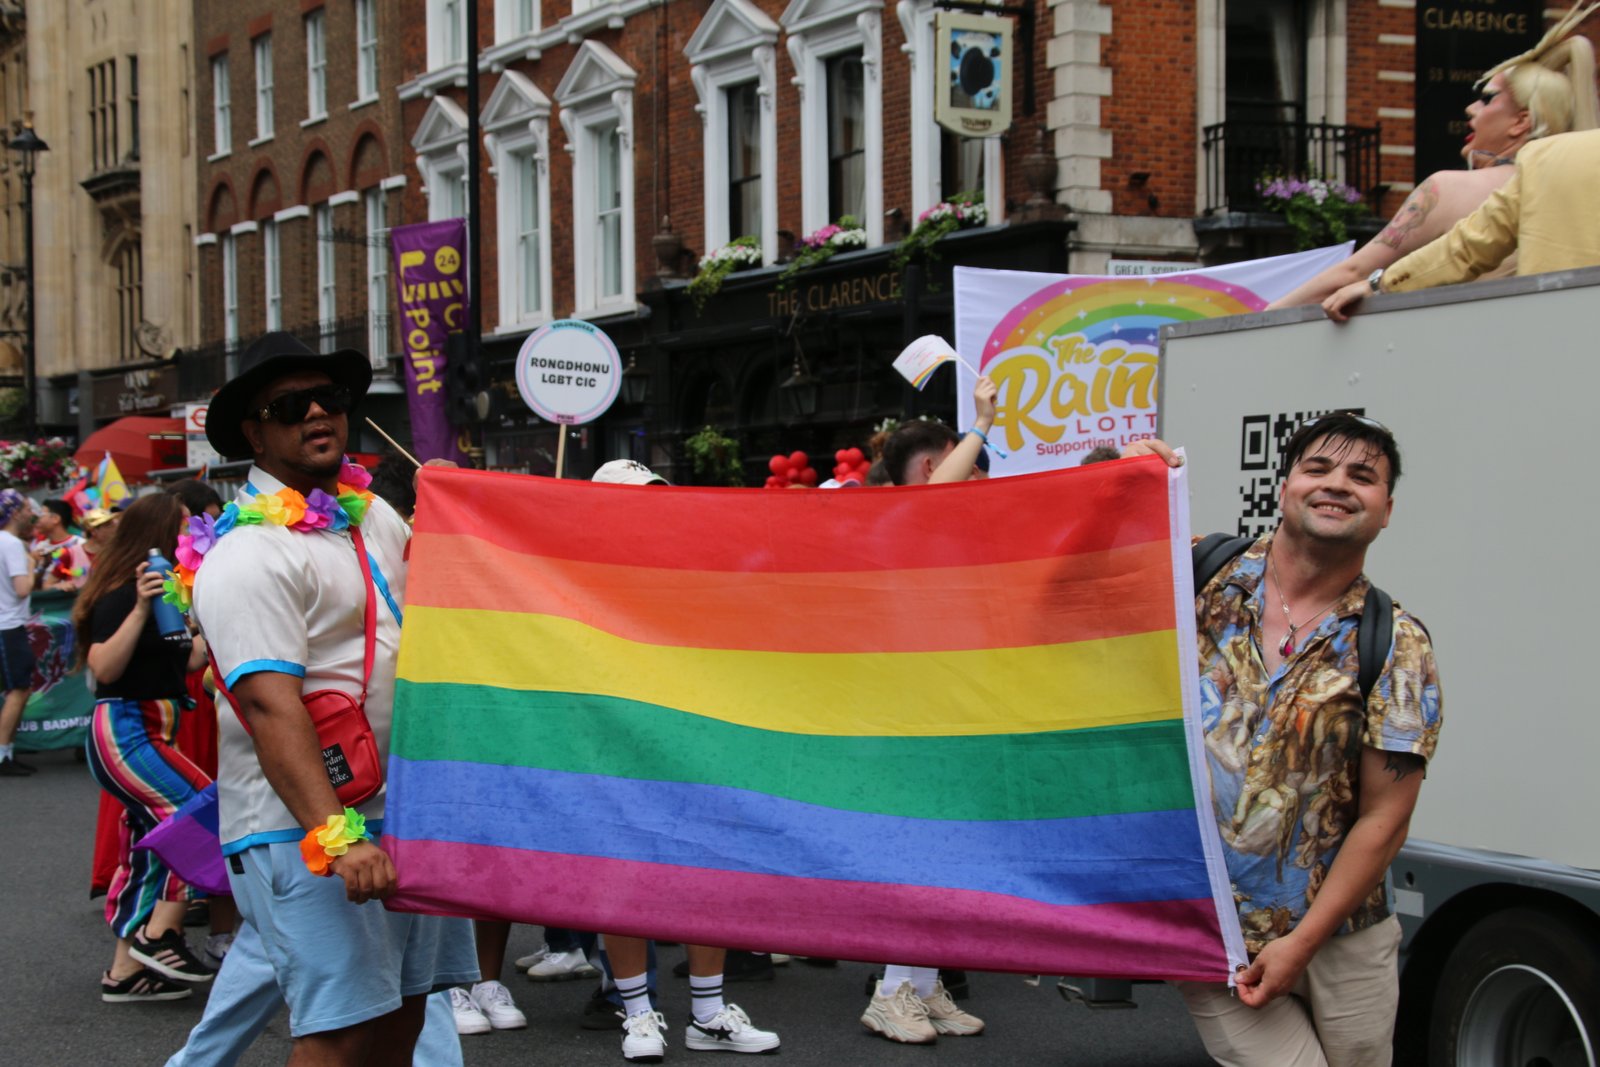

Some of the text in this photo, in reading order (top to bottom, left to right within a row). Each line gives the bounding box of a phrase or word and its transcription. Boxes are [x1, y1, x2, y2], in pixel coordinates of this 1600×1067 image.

[1424, 8, 1527, 33] CLARENCE
[438, 254, 456, 267] 24
[1115, 265, 1144, 275] GREAT
[767, 272, 900, 317] THE CLARENCE
[406, 306, 443, 396] Point
[1051, 335, 1097, 372] The
[530, 357, 610, 374] RONGDHONU
[541, 373, 597, 388] LGBT CIC
[987, 347, 1159, 452] Rain
[1076, 413, 1158, 434] LOTT
[1036, 432, 1158, 456] Supporting LGBT
[42, 716, 92, 731] BADMIN
